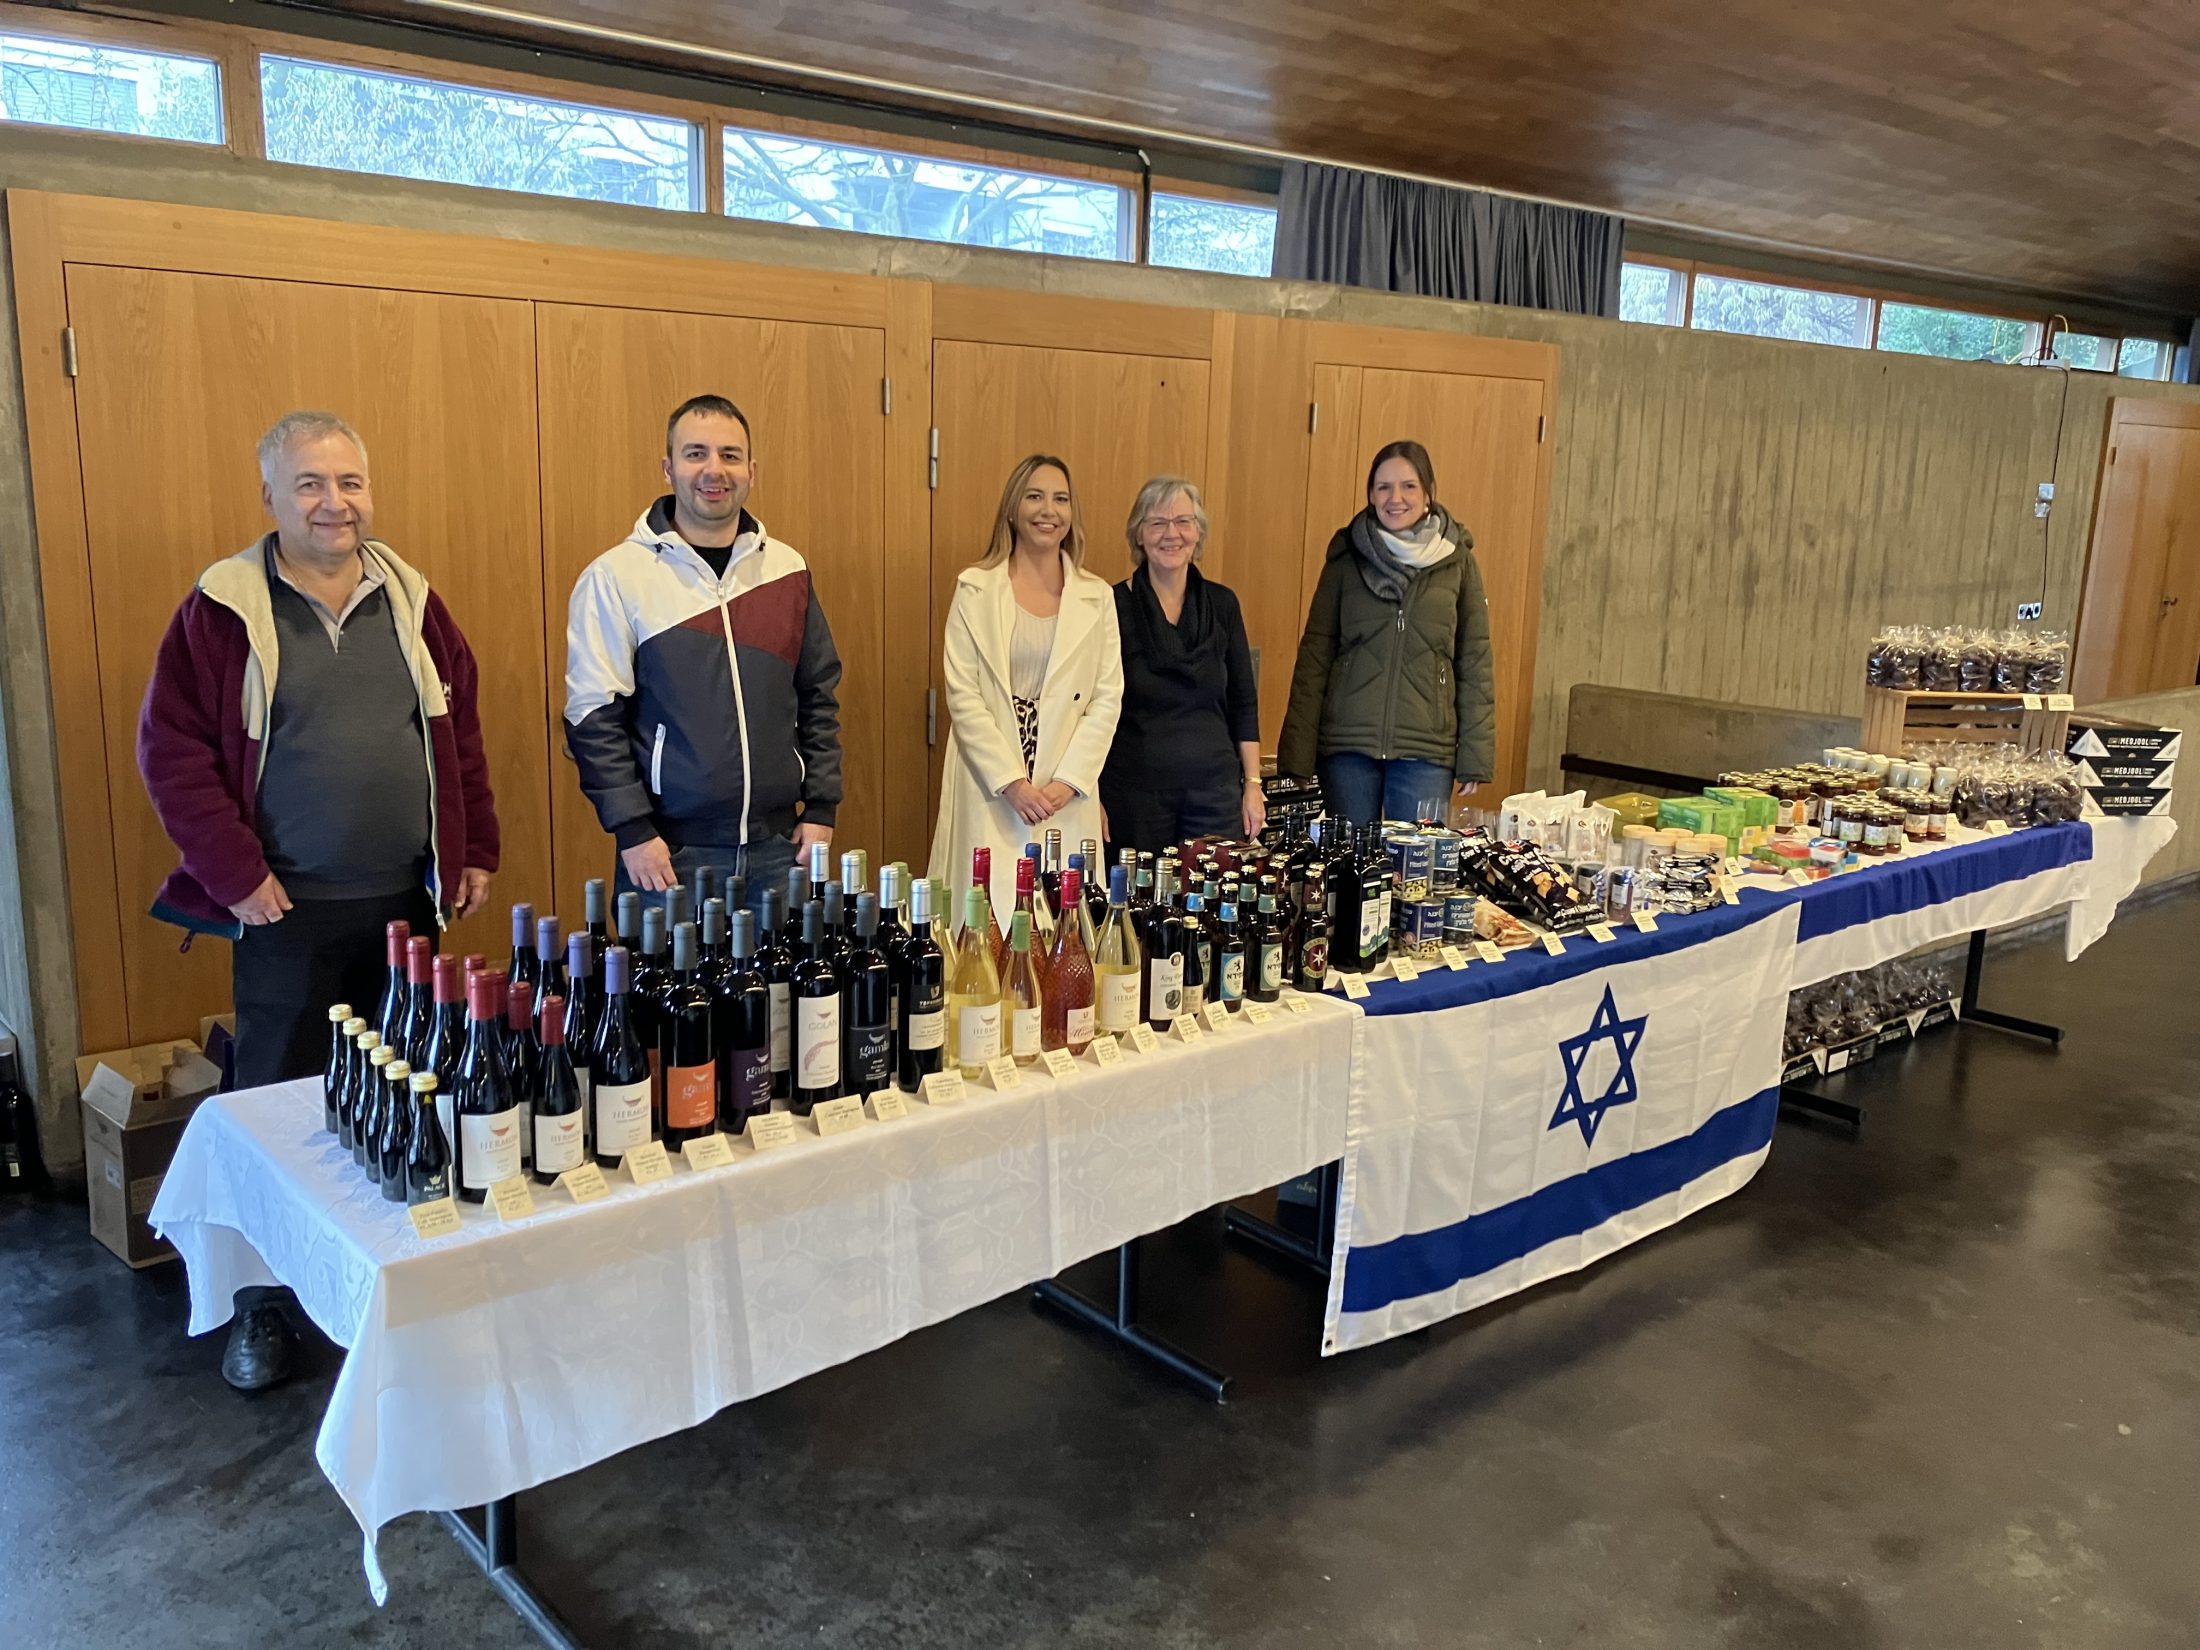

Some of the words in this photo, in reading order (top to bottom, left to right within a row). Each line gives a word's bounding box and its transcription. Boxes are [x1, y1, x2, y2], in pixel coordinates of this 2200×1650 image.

[2120, 737, 2149, 746] MEDJOOL
[2113, 767, 2142, 775] MEDJOOL
[2114, 796, 2141, 804] MEDJOOL
